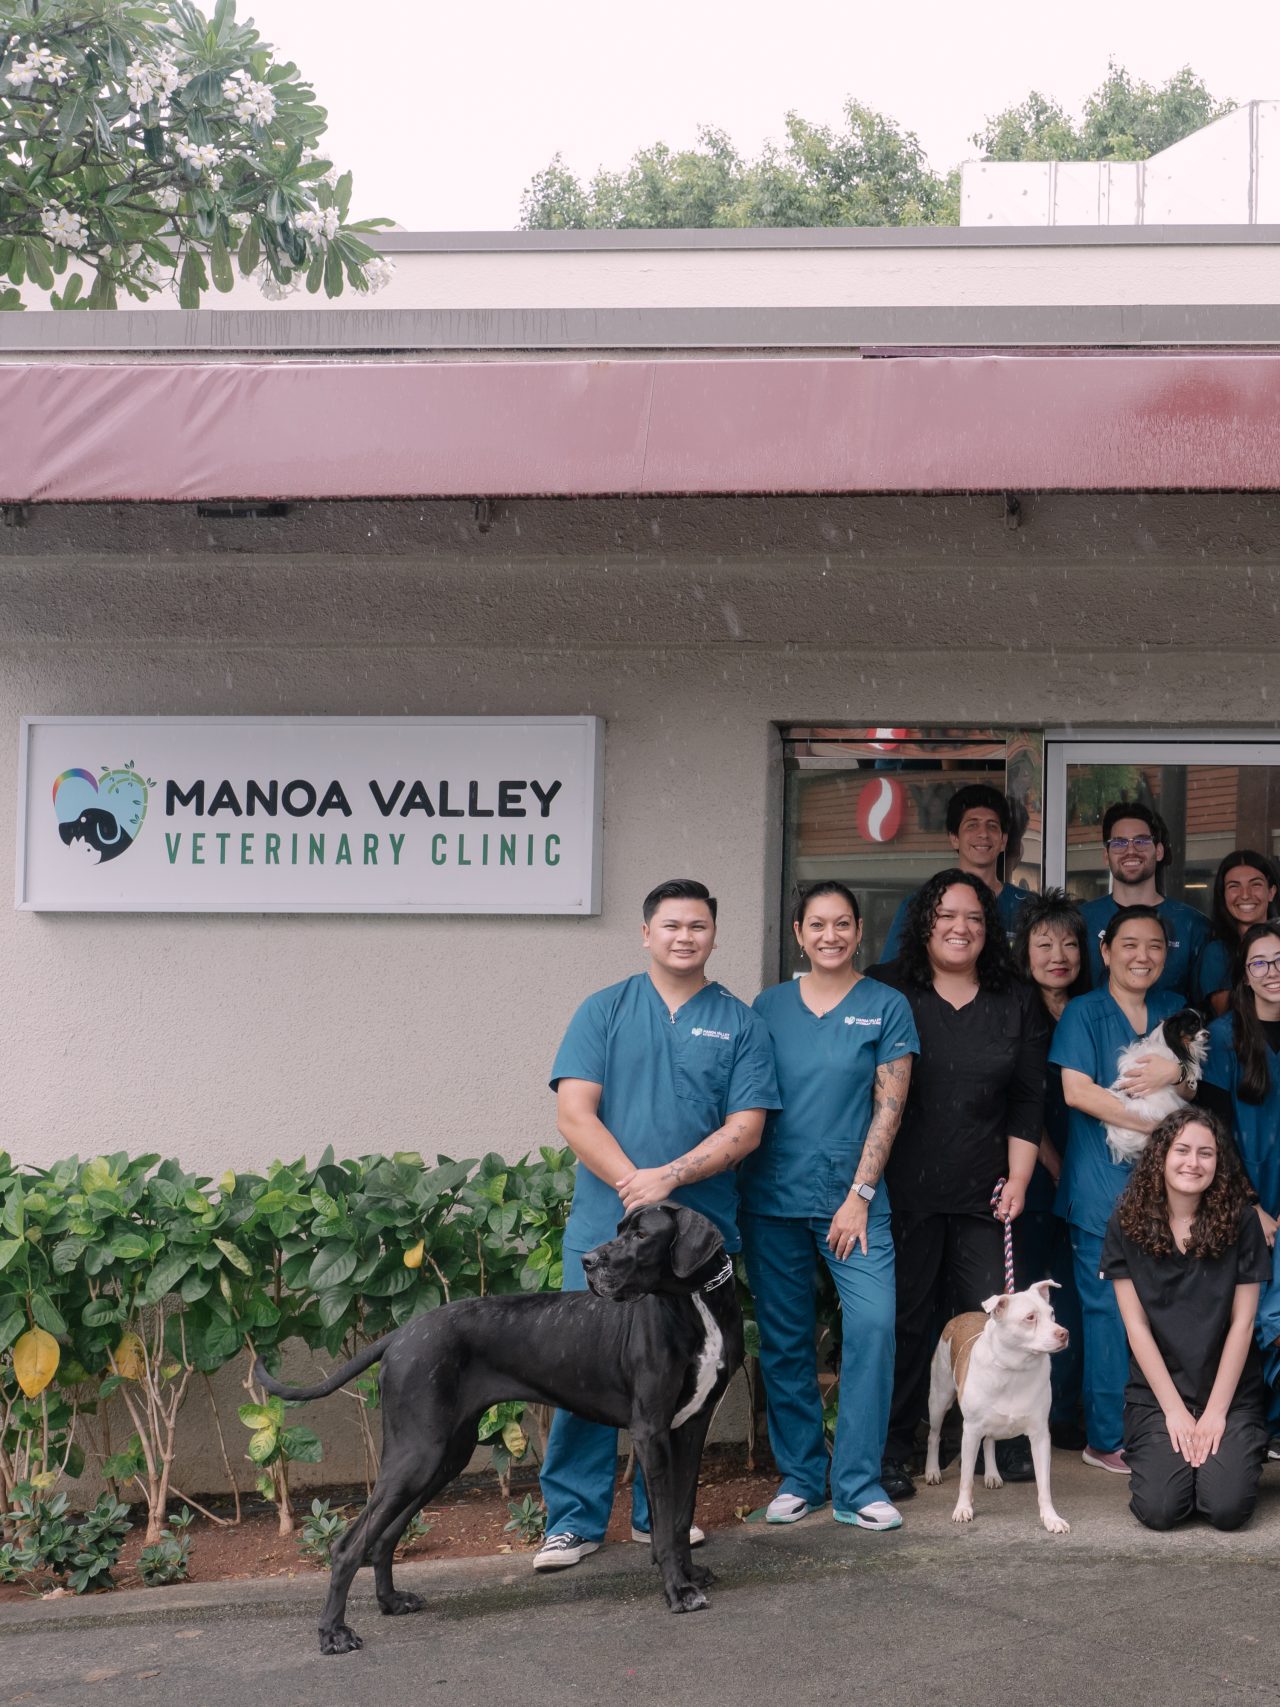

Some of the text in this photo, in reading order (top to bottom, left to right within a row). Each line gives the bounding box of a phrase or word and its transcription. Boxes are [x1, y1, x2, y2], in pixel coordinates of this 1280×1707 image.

[165, 780, 563, 818] MANOA VALLEY
[165, 832, 561, 866] VETERINARY CLINIC
